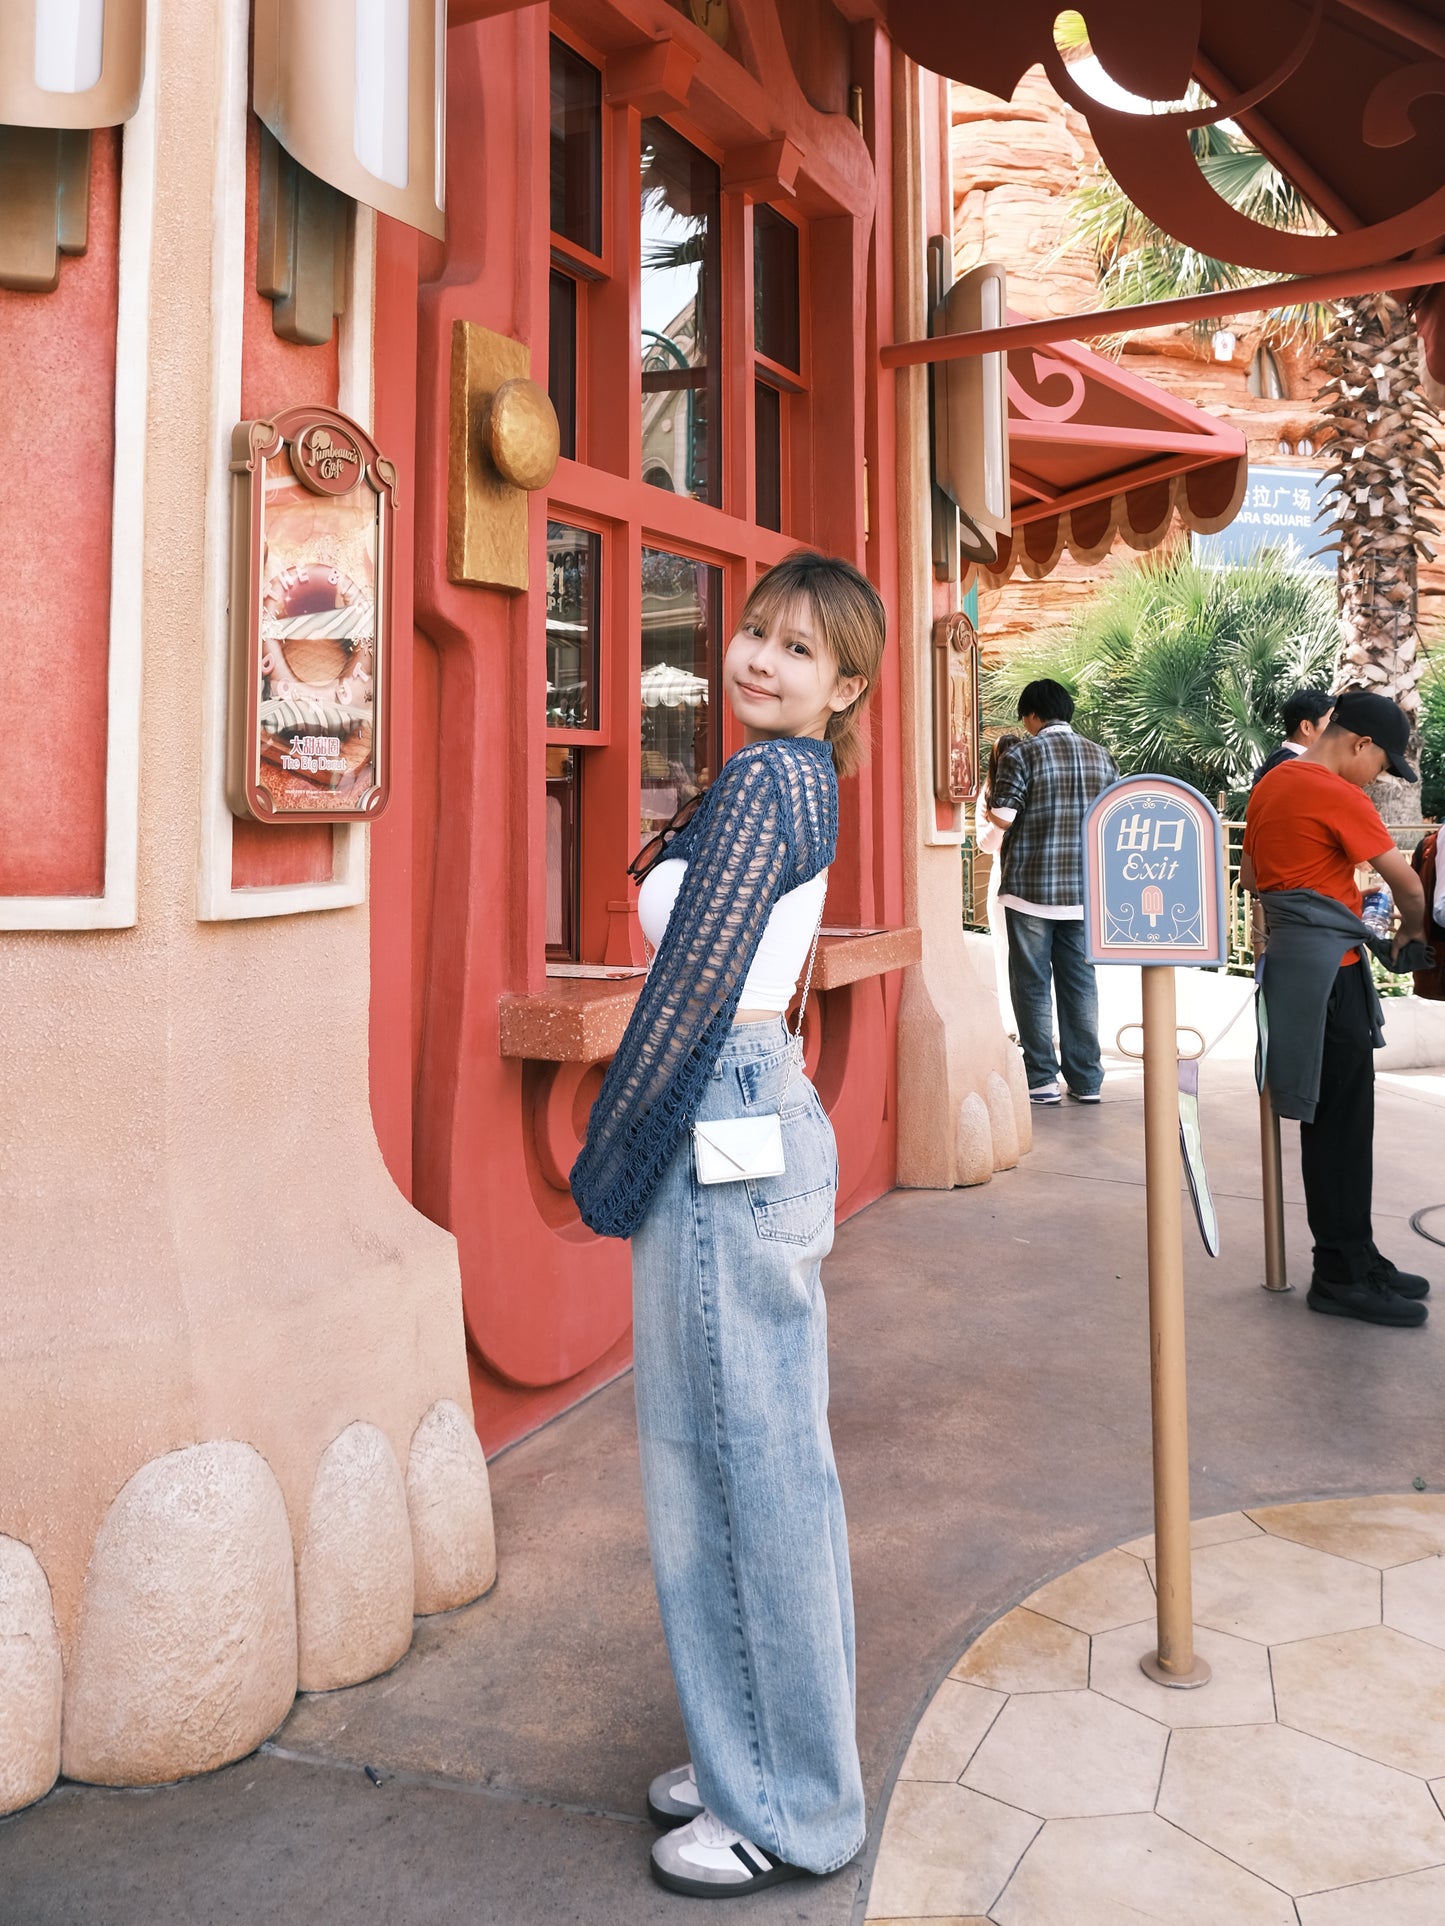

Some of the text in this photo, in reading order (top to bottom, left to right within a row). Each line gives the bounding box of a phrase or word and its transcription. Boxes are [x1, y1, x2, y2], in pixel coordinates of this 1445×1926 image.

[1234, 511, 1312, 528] ARA SQUARE
[280, 755, 300, 770] The
[301, 756, 318, 774] Big
[1116, 813, 1186, 852] 出口
[1122, 852, 1180, 881] Exit
